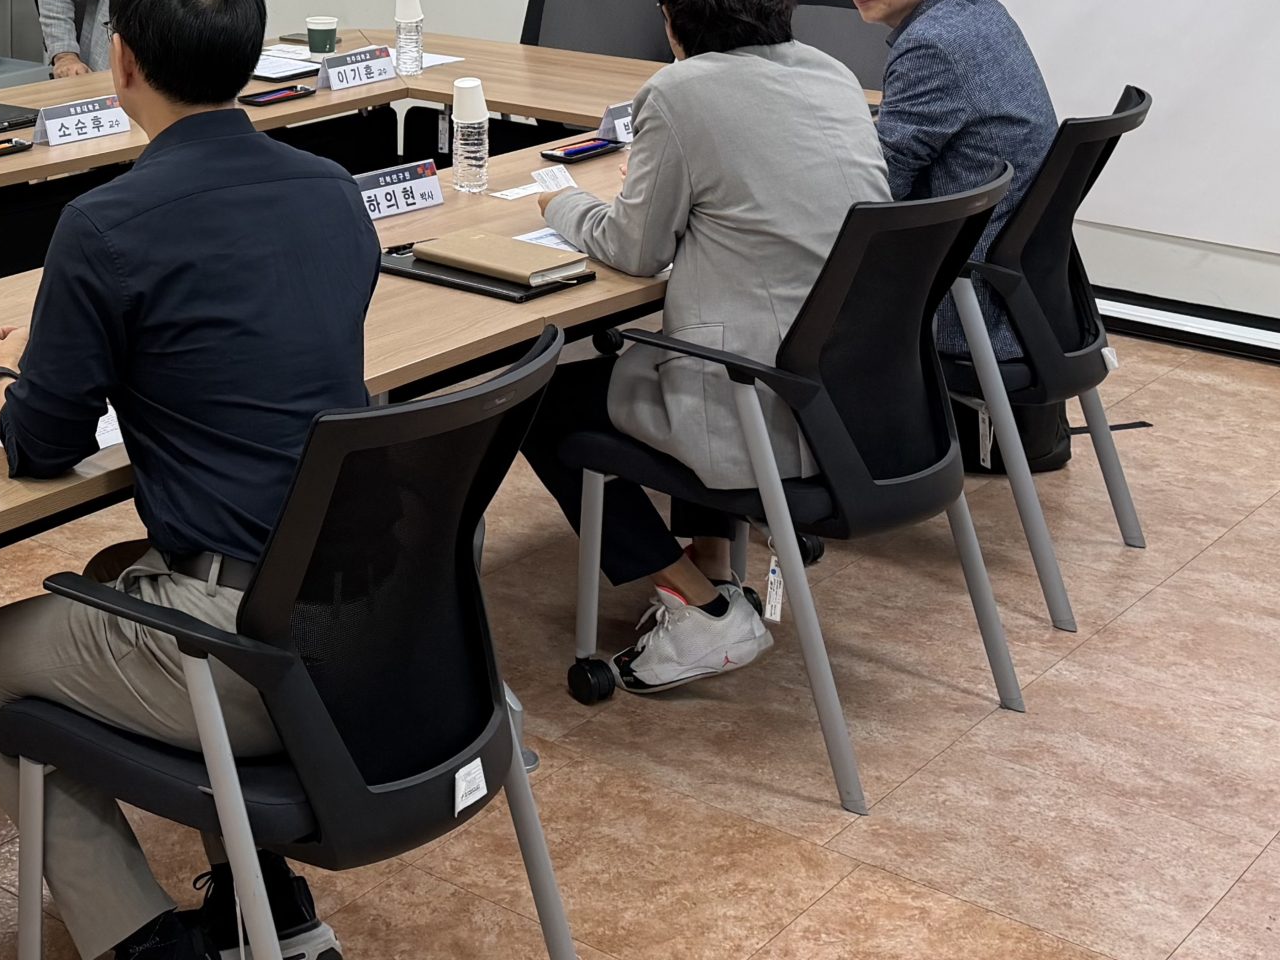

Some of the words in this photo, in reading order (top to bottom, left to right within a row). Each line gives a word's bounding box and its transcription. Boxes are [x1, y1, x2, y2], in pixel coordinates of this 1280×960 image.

[337, 64, 374, 84] 이기훈
[377, 67, 388, 77] 교수
[58, 115, 104, 138] 소순후
[108, 119, 121, 129] 교수
[366, 185, 417, 214] 하의현
[419, 190, 434, 202] 박사
